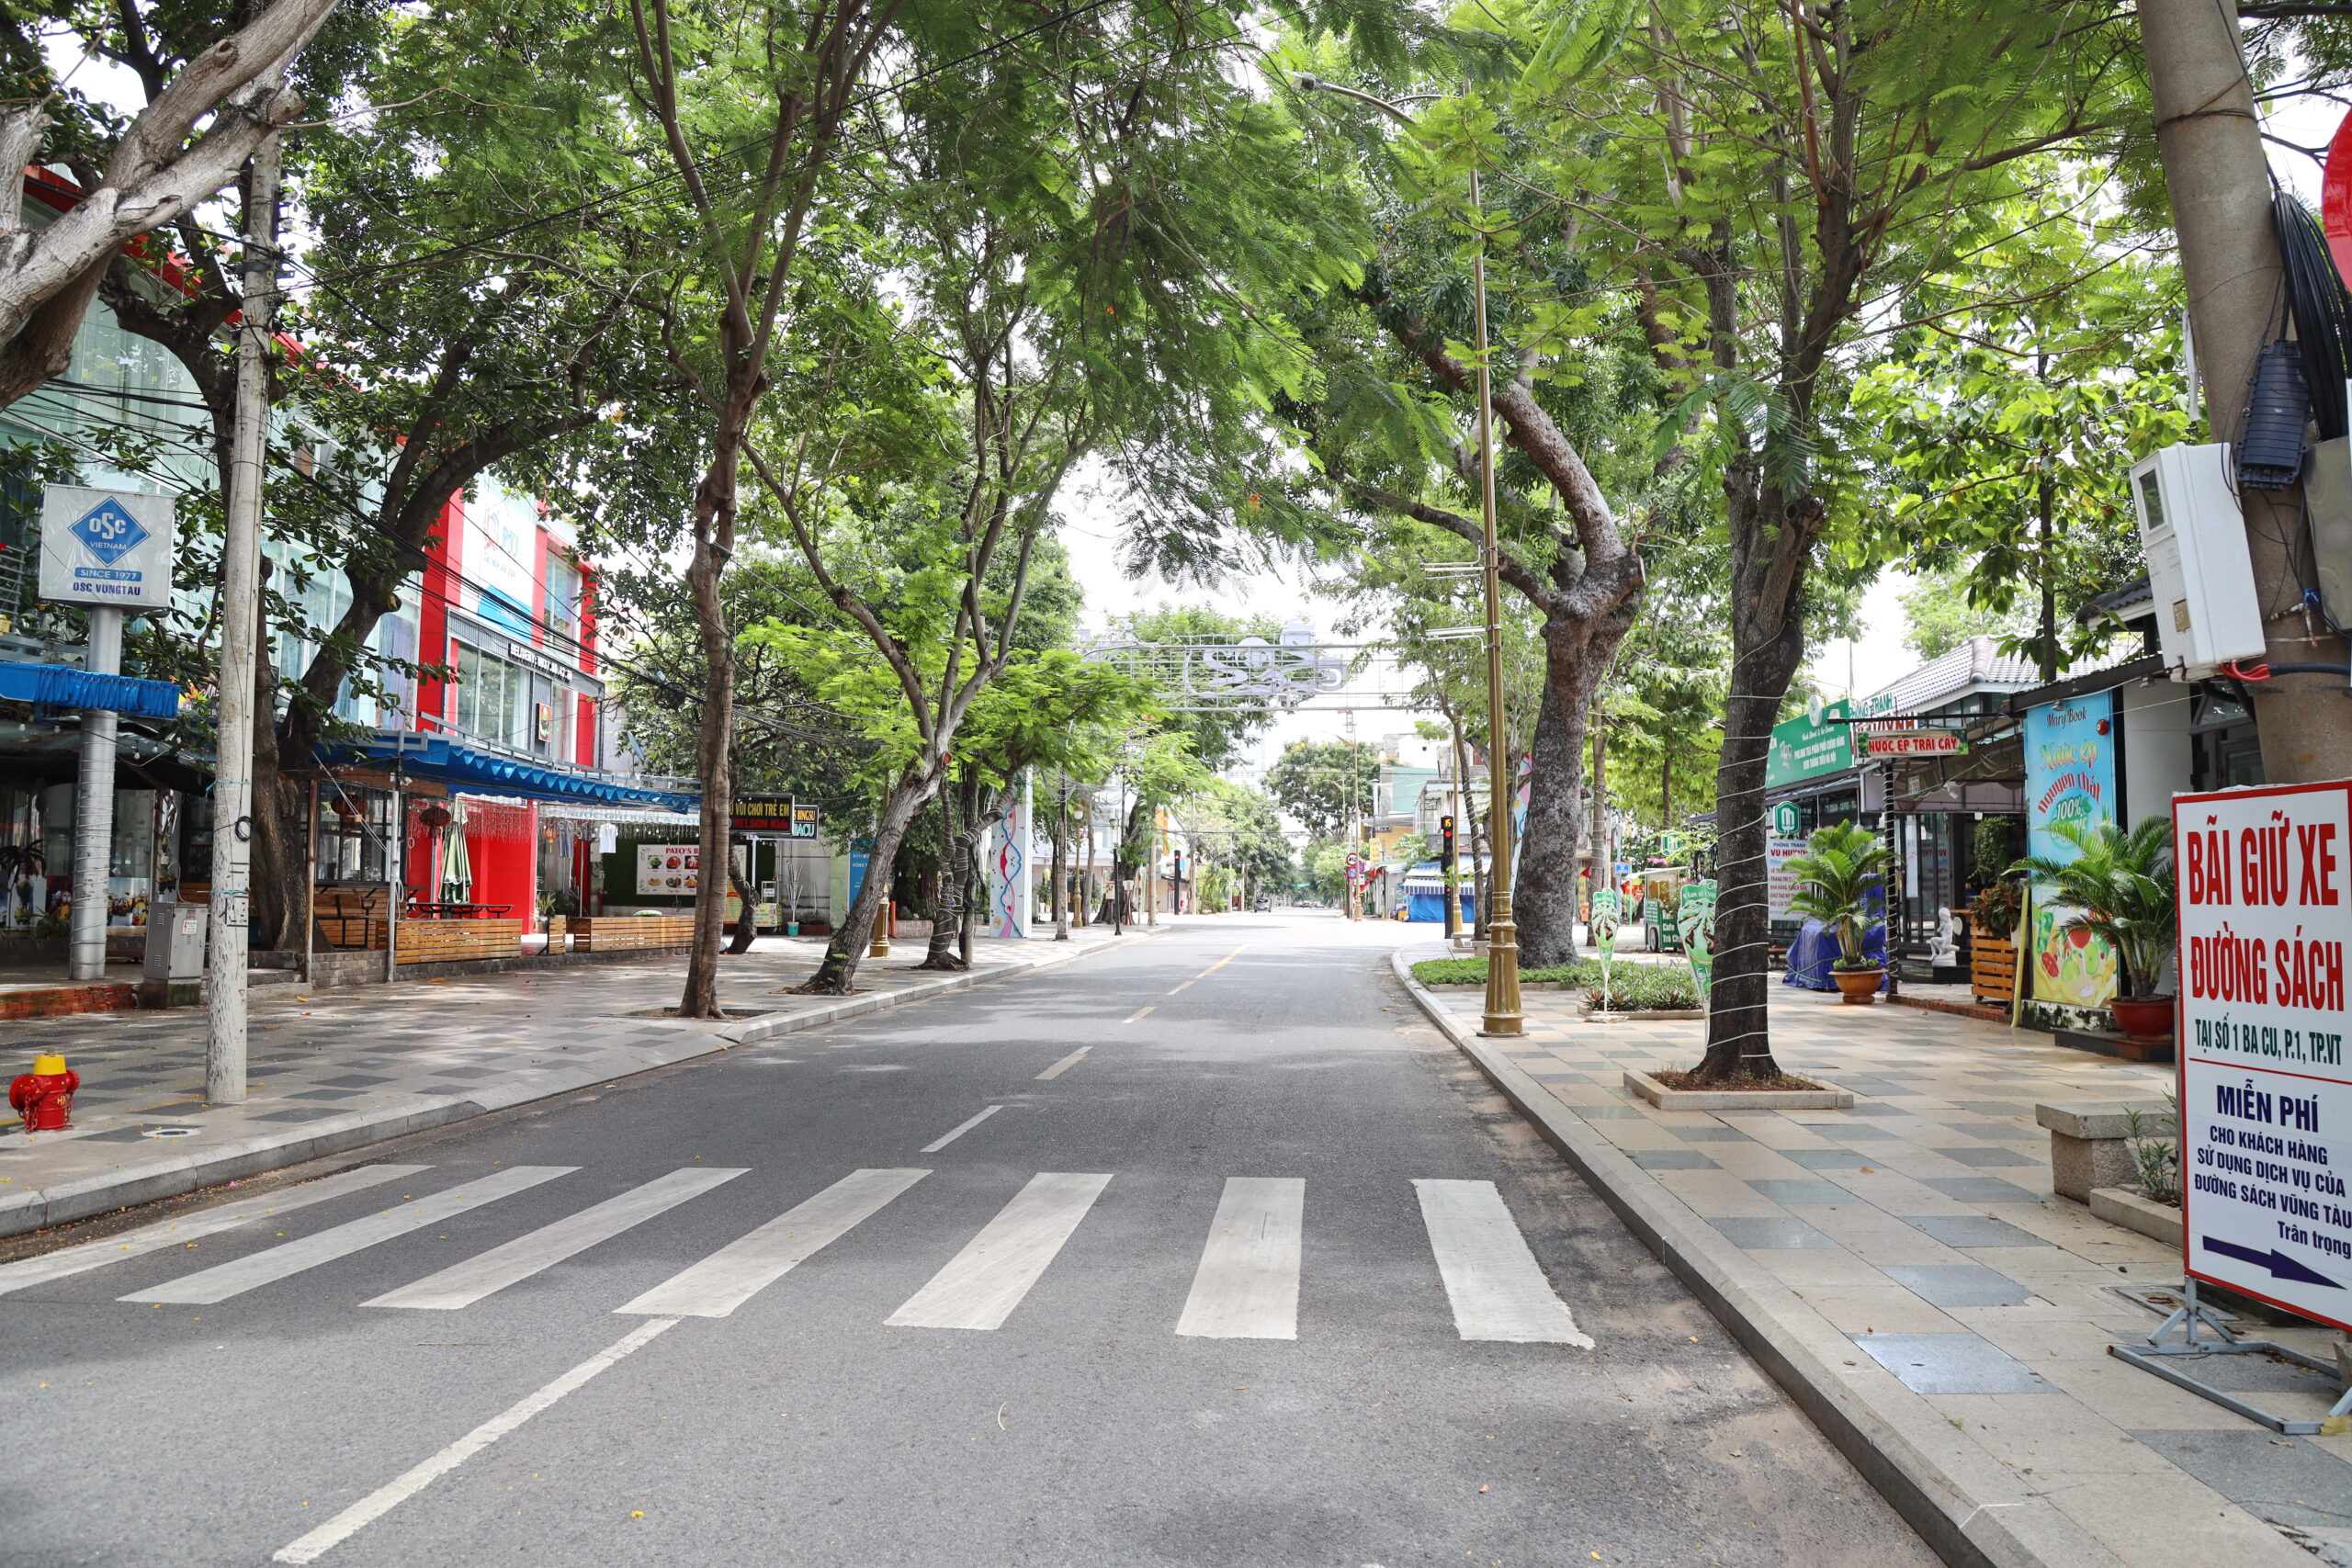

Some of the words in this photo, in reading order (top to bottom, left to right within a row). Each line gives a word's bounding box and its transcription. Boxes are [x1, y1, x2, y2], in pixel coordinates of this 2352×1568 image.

[89, 513, 126, 539] OSC
[90, 541, 127, 550] VIETNAM
[73, 582, 92, 592] OSC
[96, 584, 141, 595] VUNGTAU
[81, 570, 110, 578] SINCE
[115, 571, 137, 581] 1977
[1871, 693, 1893, 711] TRANH
[2047, 713, 2067, 729] Mary
[2067, 706, 2087, 723] Book
[1868, 736, 1894, 752] NƯỚC
[1897, 735, 1910, 751] ÉP
[1913, 735, 1936, 751] TRÁI
[1938, 735, 1958, 750] CÂY
[735, 802, 746, 816] VUI
[764, 799, 777, 816] TRẺ
[779, 803, 790, 817] EM
[2188, 815, 2232, 905] BÃI
[2240, 809, 2290, 907] GIỮ
[2297, 823, 2338, 906] XE
[2190, 921, 2267, 1005] ĐƯỜNG
[2275, 925, 2344, 1011] SÁCH
[2195, 1019, 2211, 1054] TẠI
[2215, 1012, 2230, 1050] SỐ
[2233, 1023, 2238, 1052] 1
[2243, 1024, 2258, 1055] BA
[2262, 1026, 2281, 1061] CU,
[2285, 1029, 2306, 1065] P.1,
[2309, 1032, 2342, 1066] TP.VT
[2217, 1078, 2272, 1124] MIỄN
[2279, 1094, 2319, 1133] PHÍ
[2210, 1125, 2234, 1146] CHO
[2238, 1132, 2284, 1156] KHÁCH
[2288, 1139, 2328, 1166] HÀNG
[2198, 1144, 2215, 1167] SỬ
[2217, 1152, 2252, 1176] DỤNG
[2256, 1160, 2288, 1184] DỊCH
[2291, 1168, 2311, 1192] VỤ
[2315, 1170, 2346, 1198] CỦA
[2195, 1173, 2237, 1200] ĐƯỜNG
[2241, 1184, 2277, 1210] SÁCH
[2279, 1194, 2319, 1221] VŨNG
[2323, 1204, 2352, 1229] TÀU
[2278, 1221, 2309, 1246] Trân
[2312, 1231, 2351, 1259] trọng
